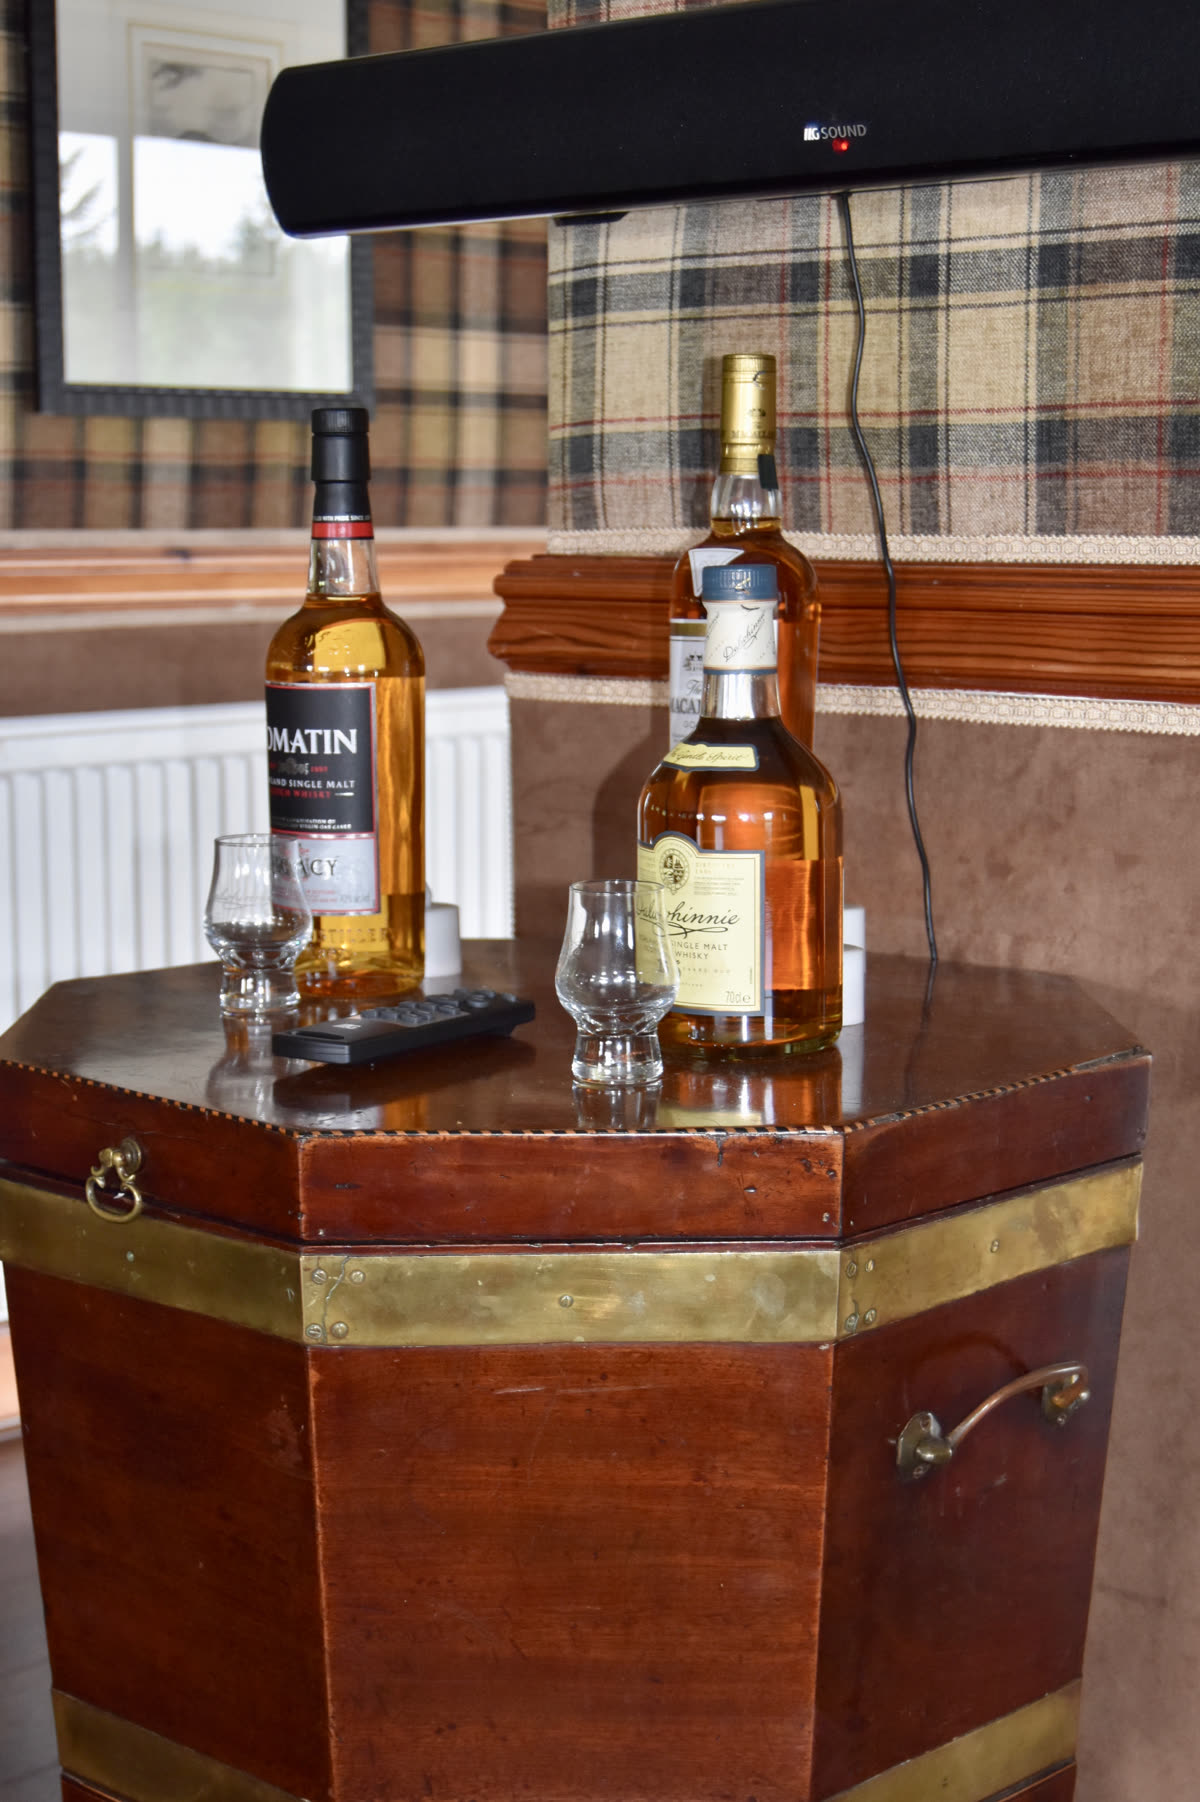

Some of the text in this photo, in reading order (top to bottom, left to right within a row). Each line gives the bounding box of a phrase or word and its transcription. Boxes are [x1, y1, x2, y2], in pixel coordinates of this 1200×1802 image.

[820, 124, 867, 139] SOUND
[288, 779, 323, 789] SINGLE
[326, 780, 356, 789] MALT
[293, 789, 331, 799] WHISKY
[703, 943, 729, 951] MALT
[674, 951, 710, 960] WHISKY
